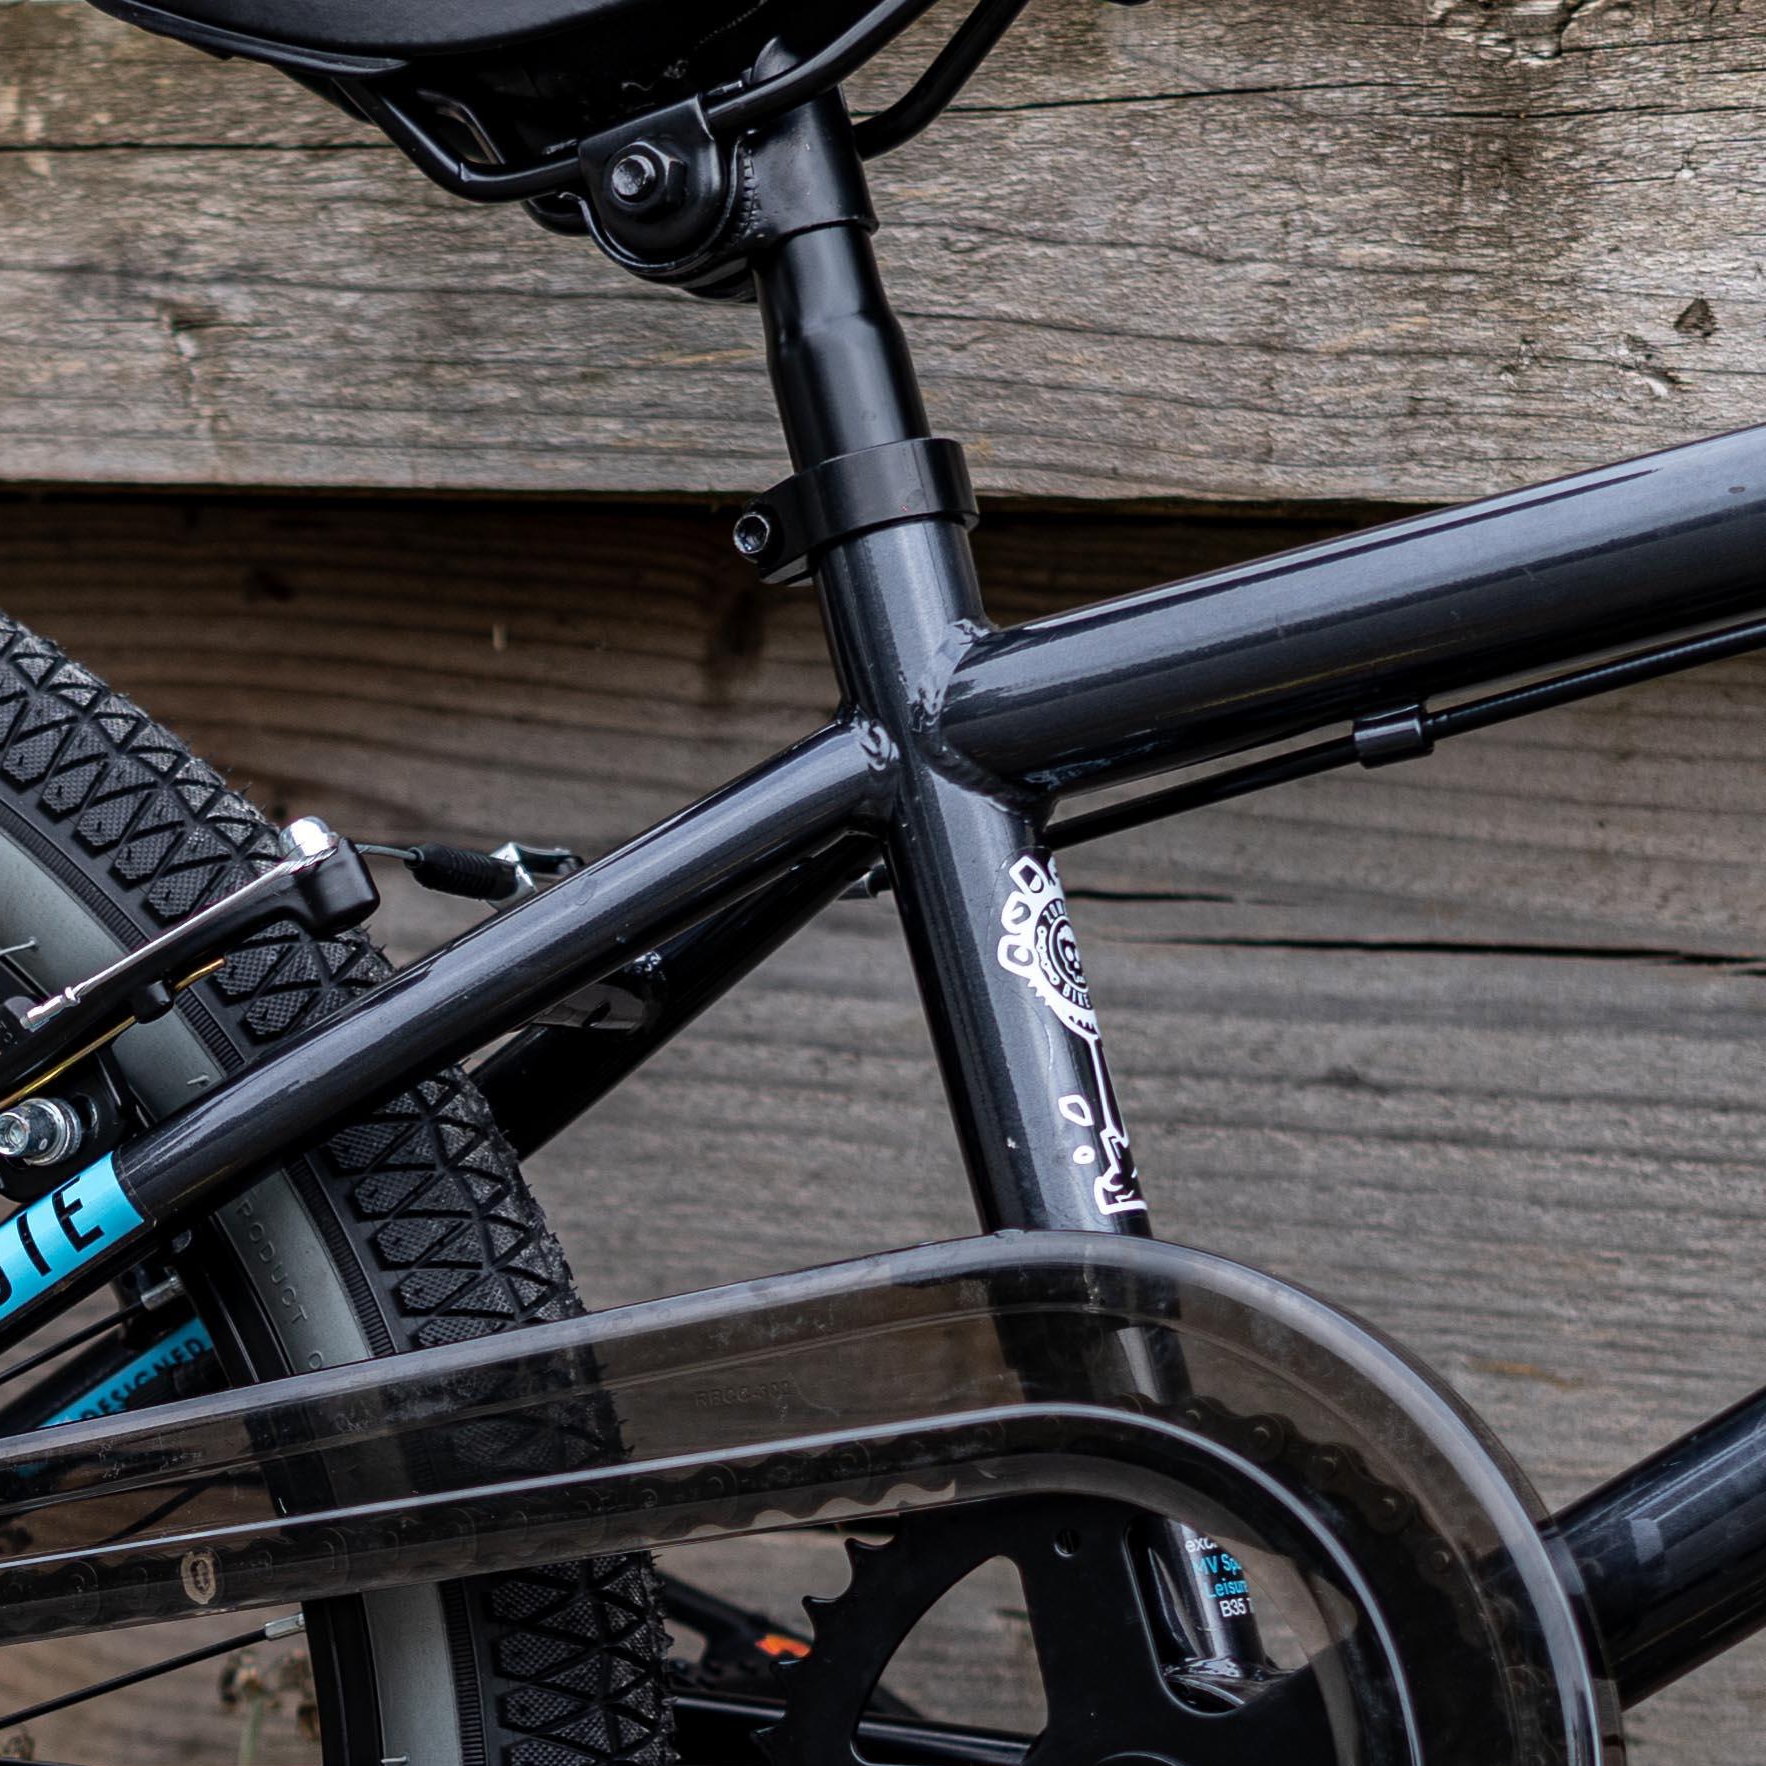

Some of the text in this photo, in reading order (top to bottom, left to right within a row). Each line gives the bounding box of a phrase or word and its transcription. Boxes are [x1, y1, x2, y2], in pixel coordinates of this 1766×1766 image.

[235, 1189, 308, 1325] RODUCT
[1202, 1578, 1250, 1599] Leisur
[1219, 1597, 1247, 1618] B35
